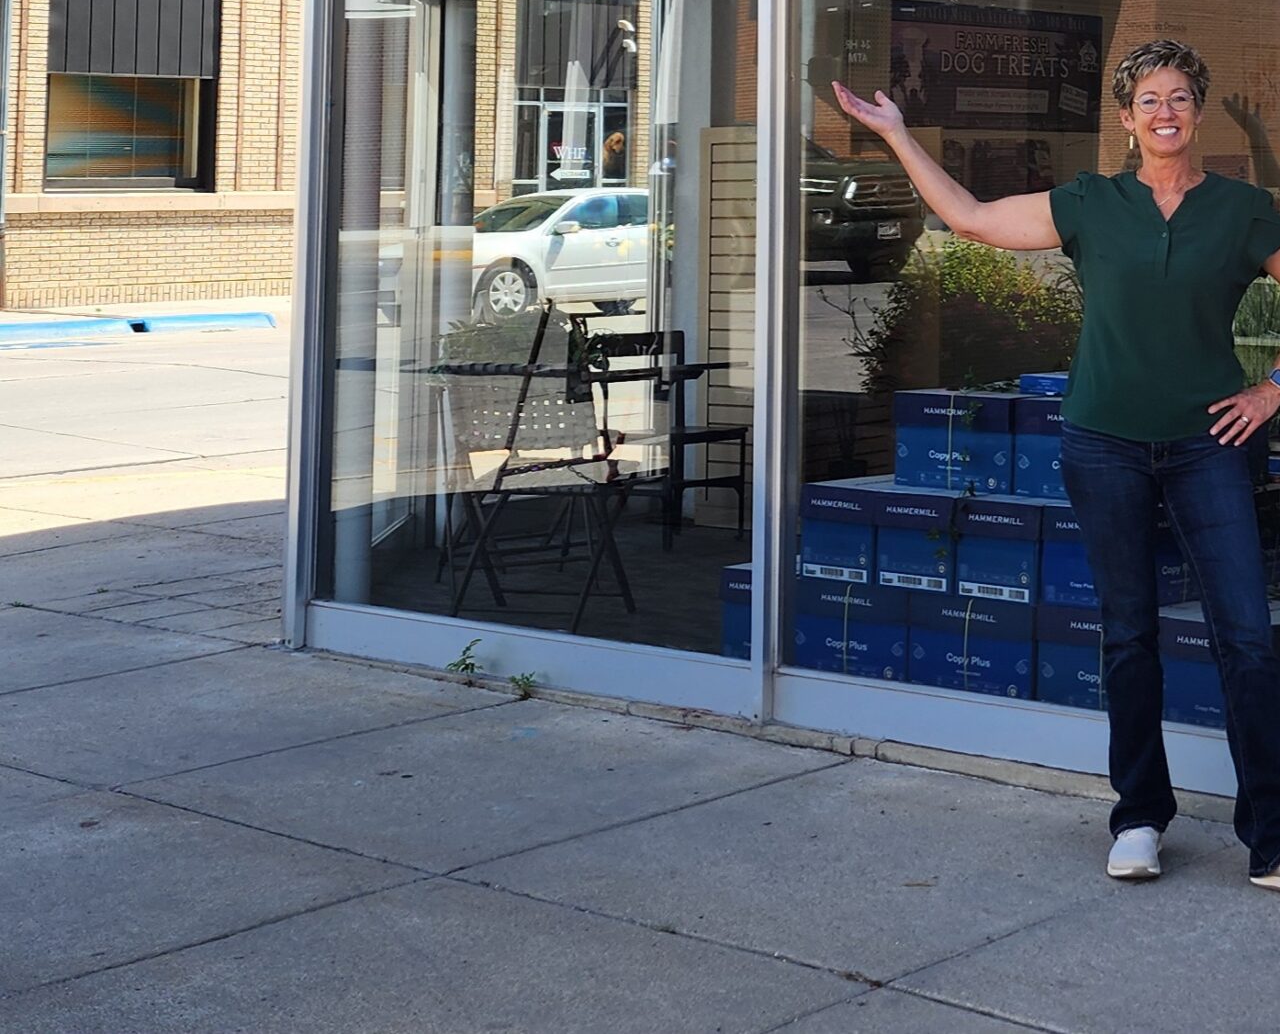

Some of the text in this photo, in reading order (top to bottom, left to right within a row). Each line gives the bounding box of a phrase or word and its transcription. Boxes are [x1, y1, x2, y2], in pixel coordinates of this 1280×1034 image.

[956, 31, 1050, 55] FARM FRESH
[940, 50, 1070, 80] DOG TREATS
[928, 450, 949, 462] Copy
[811, 498, 862, 511] HAMMERMILL
[886, 506, 939, 517] HAMMERMILL
[968, 513, 1024, 526] HAMMERMILL
[825, 637, 868, 651] Copy Plus
[945, 652, 991, 668] Copy Plus
[1077, 670, 1101, 685] Copy
